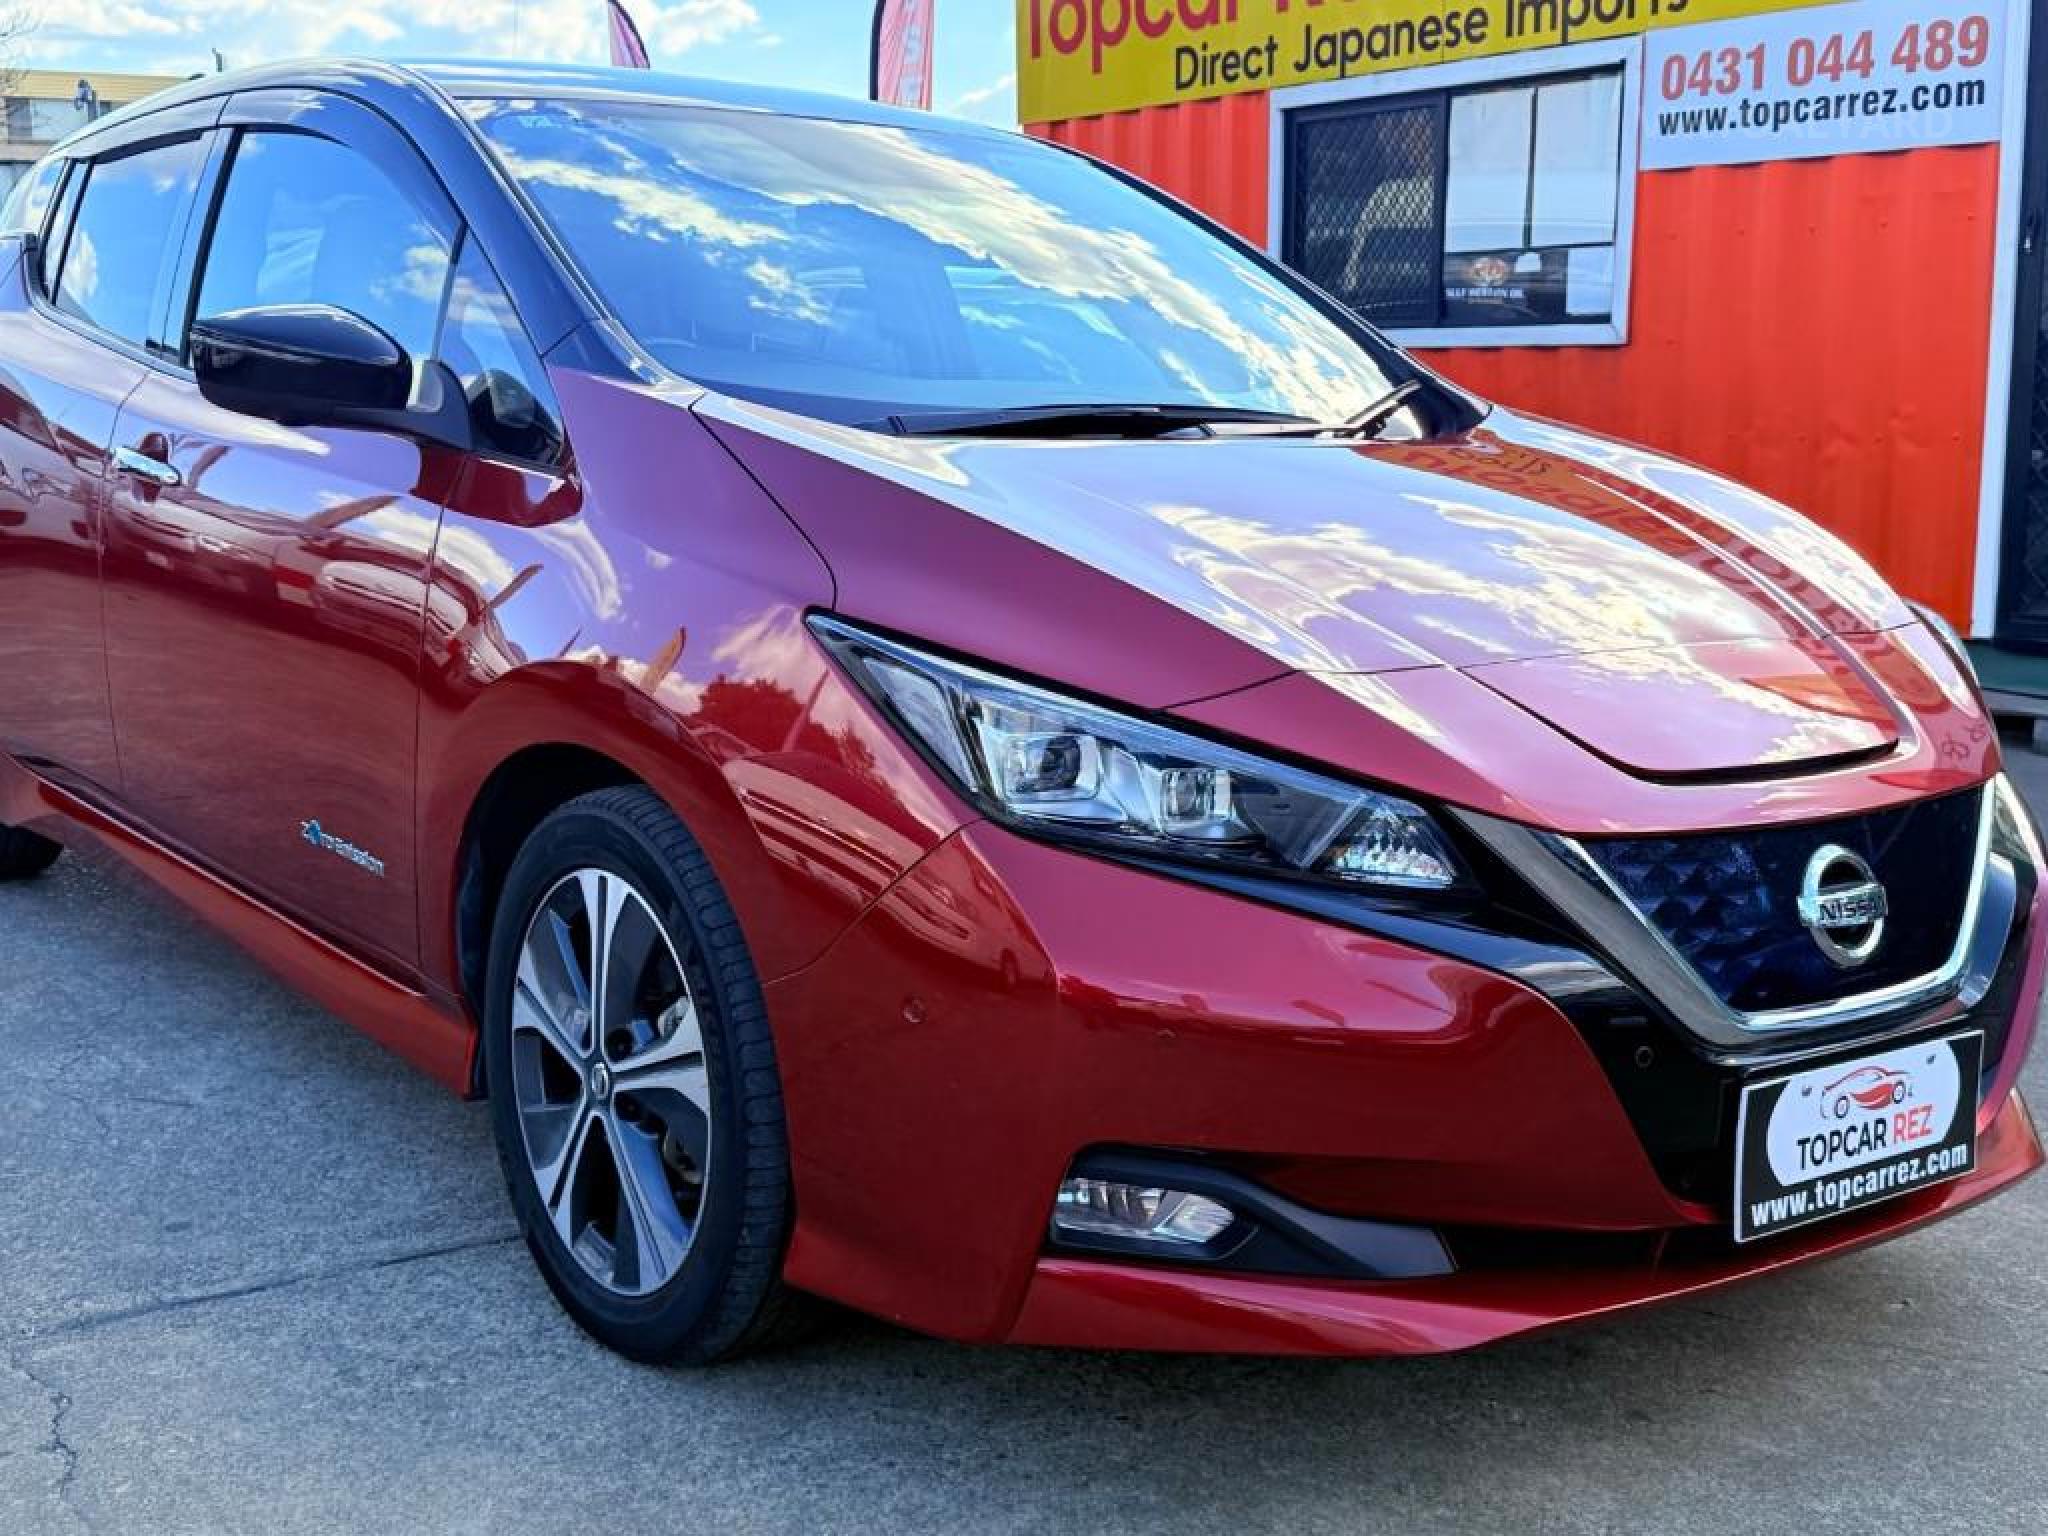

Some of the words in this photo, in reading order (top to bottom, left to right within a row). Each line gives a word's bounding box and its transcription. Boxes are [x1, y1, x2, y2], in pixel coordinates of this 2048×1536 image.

[1175, 36, 1278, 90] Direct
[1294, 7, 1489, 78] Japanese
[1661, 43, 1766, 100] 0431
[1787, 30, 1875, 86] 044
[1890, 15, 1989, 72] 489
[1658, 79, 1985, 136] www.topcarrez.com
[1796, 1118, 1887, 1170] TOPCAR
[1893, 1104, 1933, 1144] REZ
[1751, 1143, 1968, 1227] www.topcarrez.com
